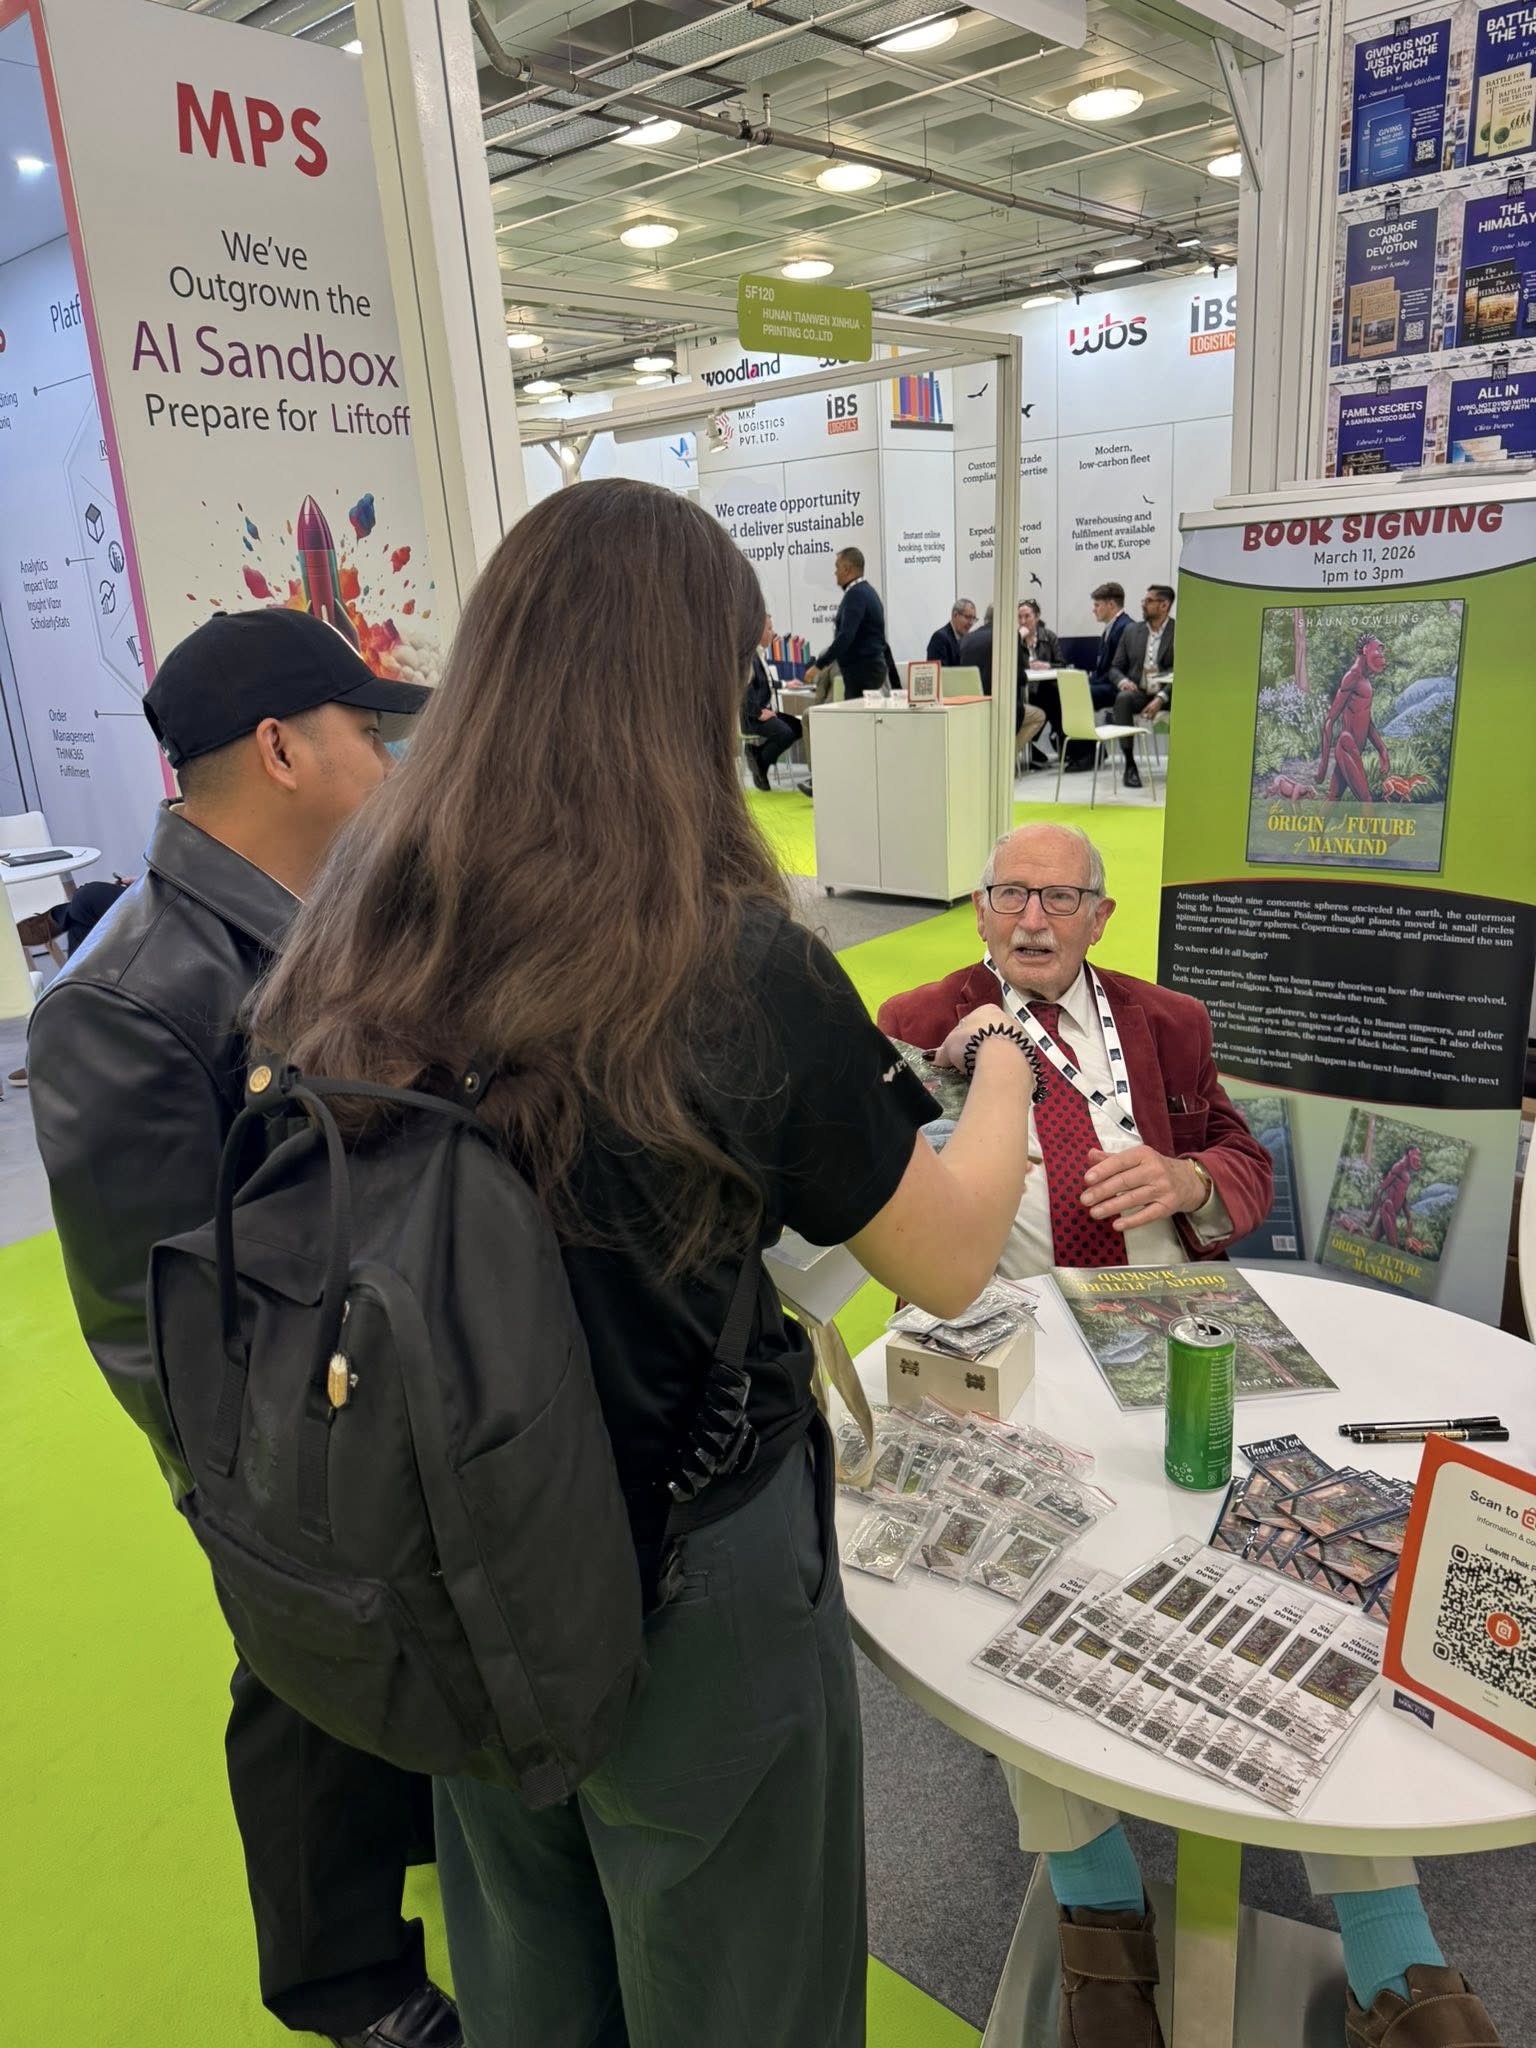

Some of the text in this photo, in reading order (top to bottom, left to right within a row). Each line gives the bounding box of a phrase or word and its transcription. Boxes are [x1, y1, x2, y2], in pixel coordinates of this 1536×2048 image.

[1488, 27, 1516, 45] THE
[1365, 32, 1439, 61] GIVING IS NOT
[1364, 43, 1438, 71] JUST FOR THE
[1372, 57, 1428, 80] VERY RICH
[176, 81, 328, 178] MPS
[1500, 202, 1525, 217] THE
[1368, 219, 1418, 239] COURAGE
[1478, 212, 1536, 233] HIMALAY
[1381, 232, 1404, 246] AND
[221, 229, 308, 271] We've
[1366, 240, 1418, 259] DEVOTION
[169, 266, 371, 317] Outgrown the
[745, 285, 775, 301] 5F120
[50, 294, 82, 332] Platf
[763, 308, 860, 329] HUNAN TIANWEN XINHUA
[763, 325, 801, 339] PRINTING
[1192, 332, 1236, 353] LOGISTIC
[132, 320, 399, 388] AI Sandbox
[701, 353, 781, 387] woodland
[1478, 384, 1519, 400] ALL IN
[145, 393, 410, 436] Prepare for Liftoff
[738, 409, 756, 420] MKF
[1341, 401, 1423, 419] FAMILY SECRETS
[1363, 413, 1398, 424] FRANCISCO
[1399, 412, 1416, 420] SAGA
[739, 418, 785, 433] LOGISTICS
[828, 420, 858, 434] LOGISTICS
[739, 432, 779, 446] PVT. LTD.
[968, 454, 1042, 471] Custom trade
[1079, 454, 1151, 470] low-carbon fleet
[963, 466, 1048, 483] complian pertise
[715, 490, 861, 518] We create opportunity
[740, 520, 784, 539] deliver
[787, 512, 864, 533] sustainable
[1075, 512, 1152, 527] Warehousing and
[1243, 504, 1504, 551] BOOK SIGNING
[903, 531, 941, 540] Instant online
[969, 526, 996, 537] Expedi
[1072, 524, 1155, 539] fulfilment available
[742, 539, 834, 561] supply chains.
[923, 542, 945, 552] tracking
[1075, 541, 1083, 551] in
[1084, 540, 1099, 550] the
[1118, 537, 1151, 549] Europe
[904, 554, 941, 565] and reporting
[969, 550, 993, 561] global
[1093, 551, 1131, 562] and USA
[1314, 546, 1416, 565] March 11, 2026
[20, 560, 48, 577] Analytics
[1322, 566, 1404, 585] 1pm to 3pm
[23, 579, 58, 593] Impact Vizor
[27, 599, 62, 611] Insight Vizor
[30, 617, 70, 630] ScholarlyStats
[1297, 613, 1420, 628] SHAUN DOWLING
[49, 709, 67, 722] Order
[53, 729, 95, 744] Management
[56, 747, 84, 760] THINK365
[1267, 814, 1416, 836] ORIGIN FUTURE
[1307, 837, 1387, 856] MANKIND
[1177, 892, 1209, 902] Aristotle
[1213, 894, 1242, 905] thought
[1246, 897, 1263, 905] nine
[1267, 899, 1311, 909] concentric
[1315, 901, 1348, 912] spheres
[1352, 904, 1392, 915] encircled
[1397, 907, 1411, 916] the
[1447, 910, 1461, 920] the
[1466, 913, 1516, 923] outermost
[1177, 902, 1196, 912] being
[1200, 904, 1212, 912] the
[1253, 908, 1290, 918] Claudius
[1294, 911, 1327, 922] Ptolemy
[1332, 913, 1364, 925] thought
[1369, 916, 1400, 927] planets
[1405, 919, 1435, 930] moved
[1439, 921, 1448, 930] in
[1452, 923, 1477, 933] small
[1482, 925, 1514, 935] circles
[1175, 923, 1187, 931] the
[1188, 925, 1212, 933] center
[1214, 925, 1222, 934] of
[1224, 926, 1237, 935] the
[1238, 928, 1256, 937] solar
[1174, 943, 1268, 961] So where did it all begin?
[1331, 1238, 1422, 1279] ORIGIN FUTURE
[1098, 1270, 1176, 1283] MANKIND
[1352, 1259, 1403, 1284] MANKIND
[1242, 1437, 1302, 1457] Thank You
[1469, 1490, 1519, 1519] Scan to
[1477, 1516, 1525, 1541] information &
[1484, 1543, 1530, 1570] Leavitt Peak
[1340, 1641, 1382, 1668] Dowling
[1349, 1638, 1380, 1657] Shaun
